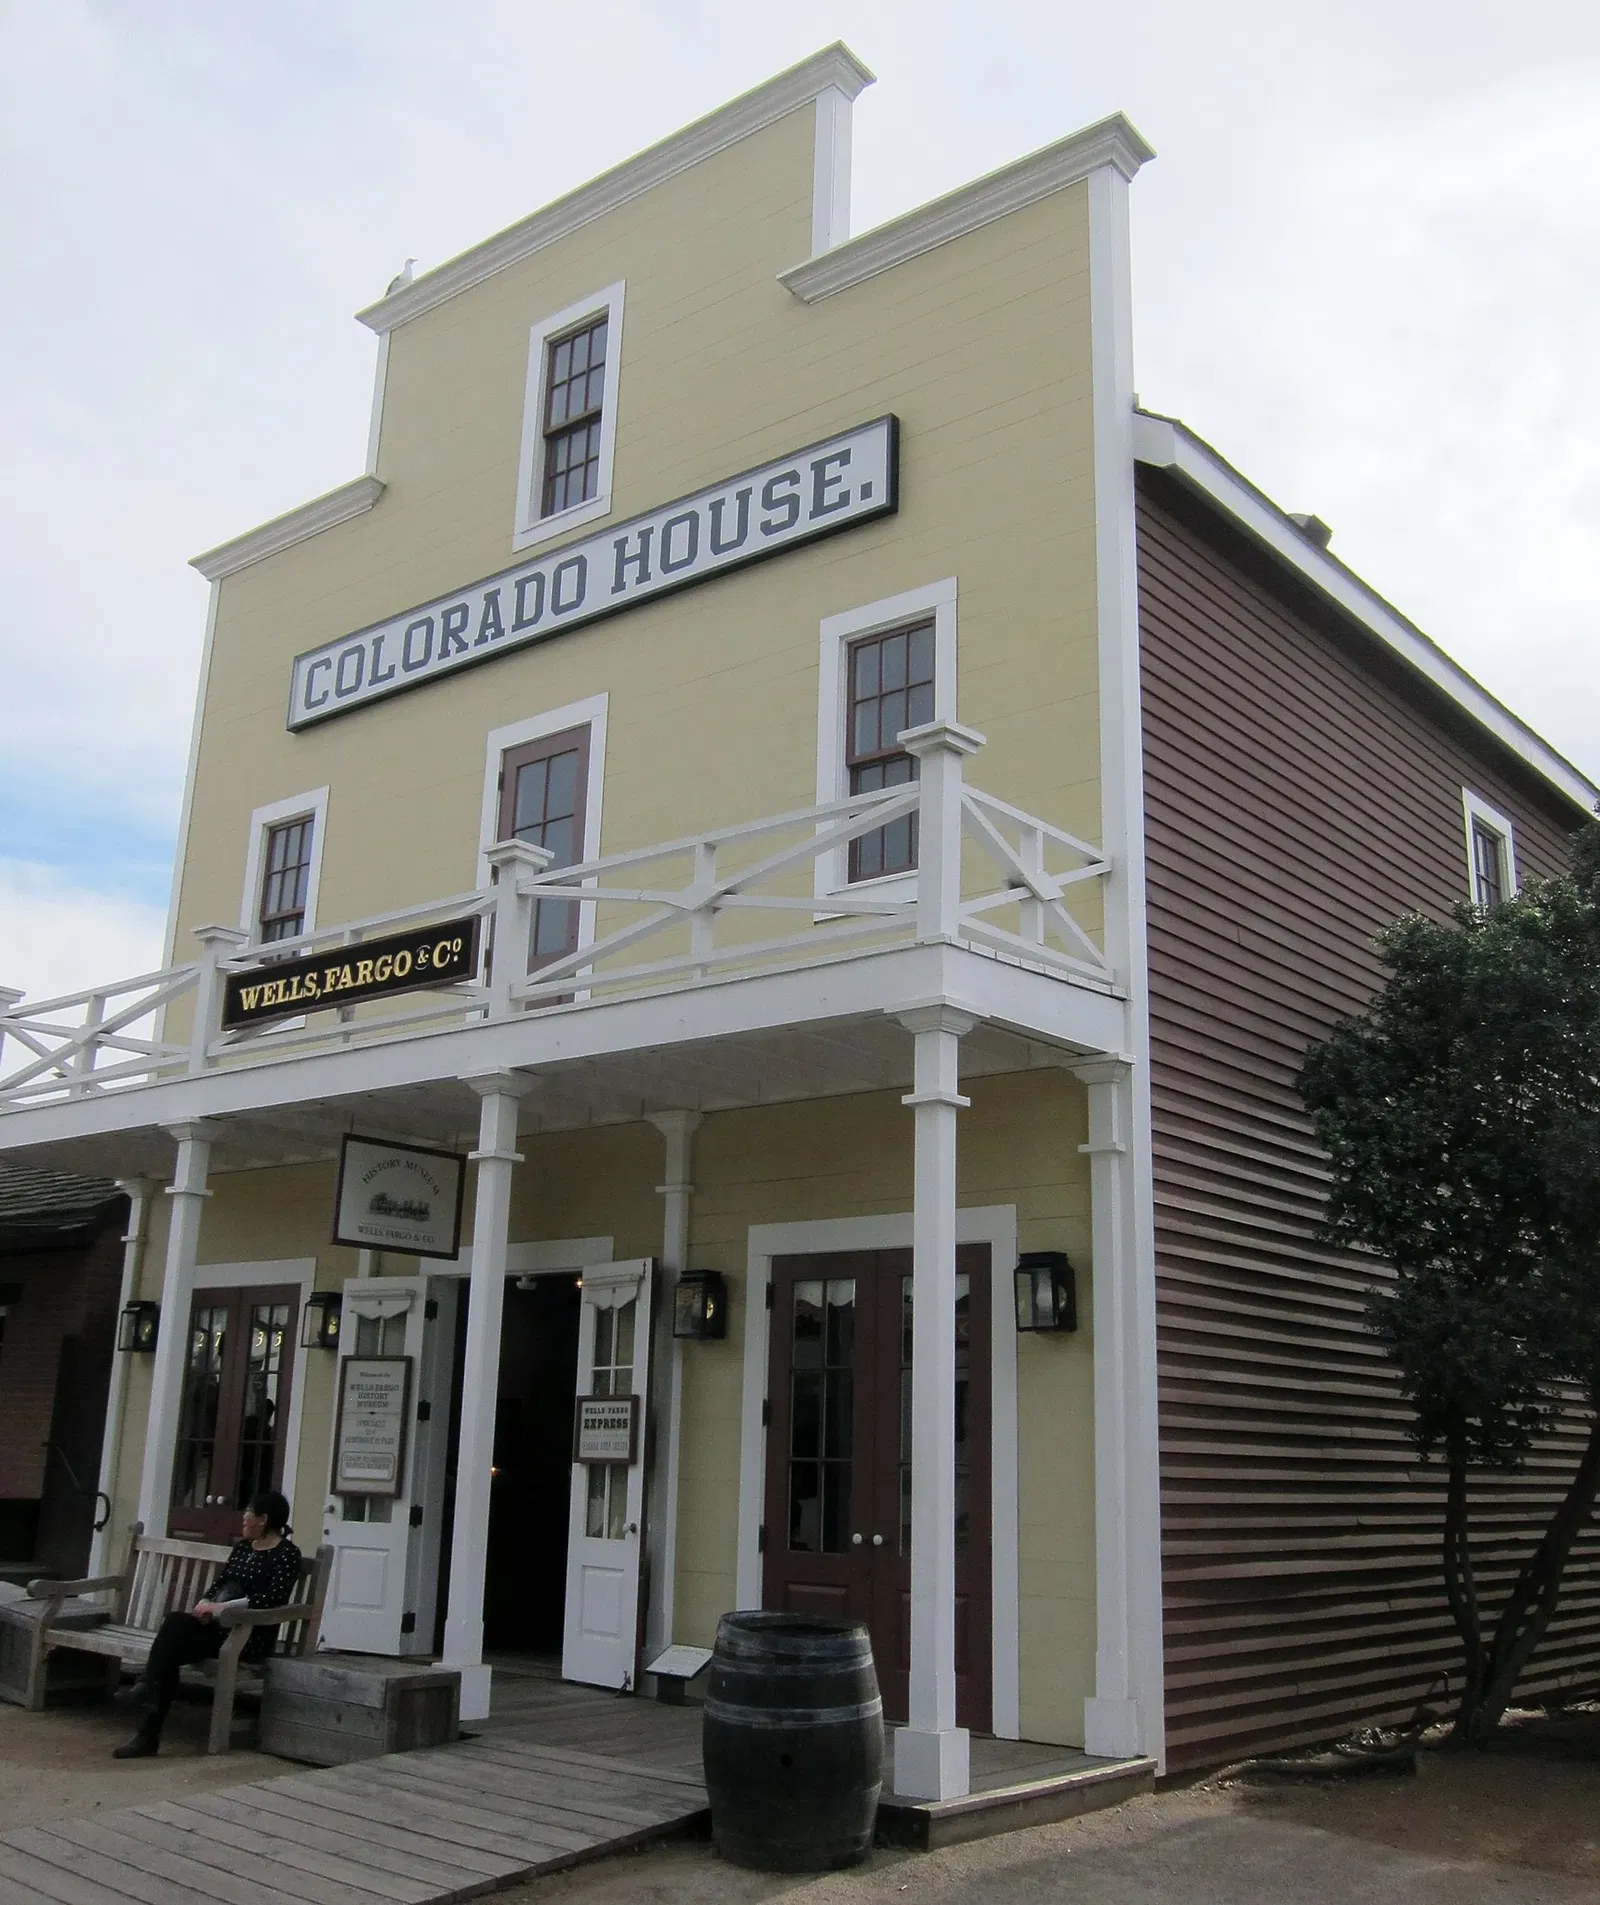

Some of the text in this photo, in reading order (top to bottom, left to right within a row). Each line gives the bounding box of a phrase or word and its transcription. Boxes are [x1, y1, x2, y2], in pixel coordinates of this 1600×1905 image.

[304, 447, 874, 711] COLORADO HOUSE.
[239, 972, 321, 1012] WELLS,
[321, 950, 412, 993] FARGO
[362, 1158, 440, 1196] HISTORY MUSEUM
[386, 1229, 412, 1240] FARGO
[350, 1383, 399, 1391] WELLS FARGO
[358, 1392, 389, 1400] HISTORY
[357, 1400, 389, 1408] MUSEUM
[584, 1418, 628, 1429] EXPRESS
